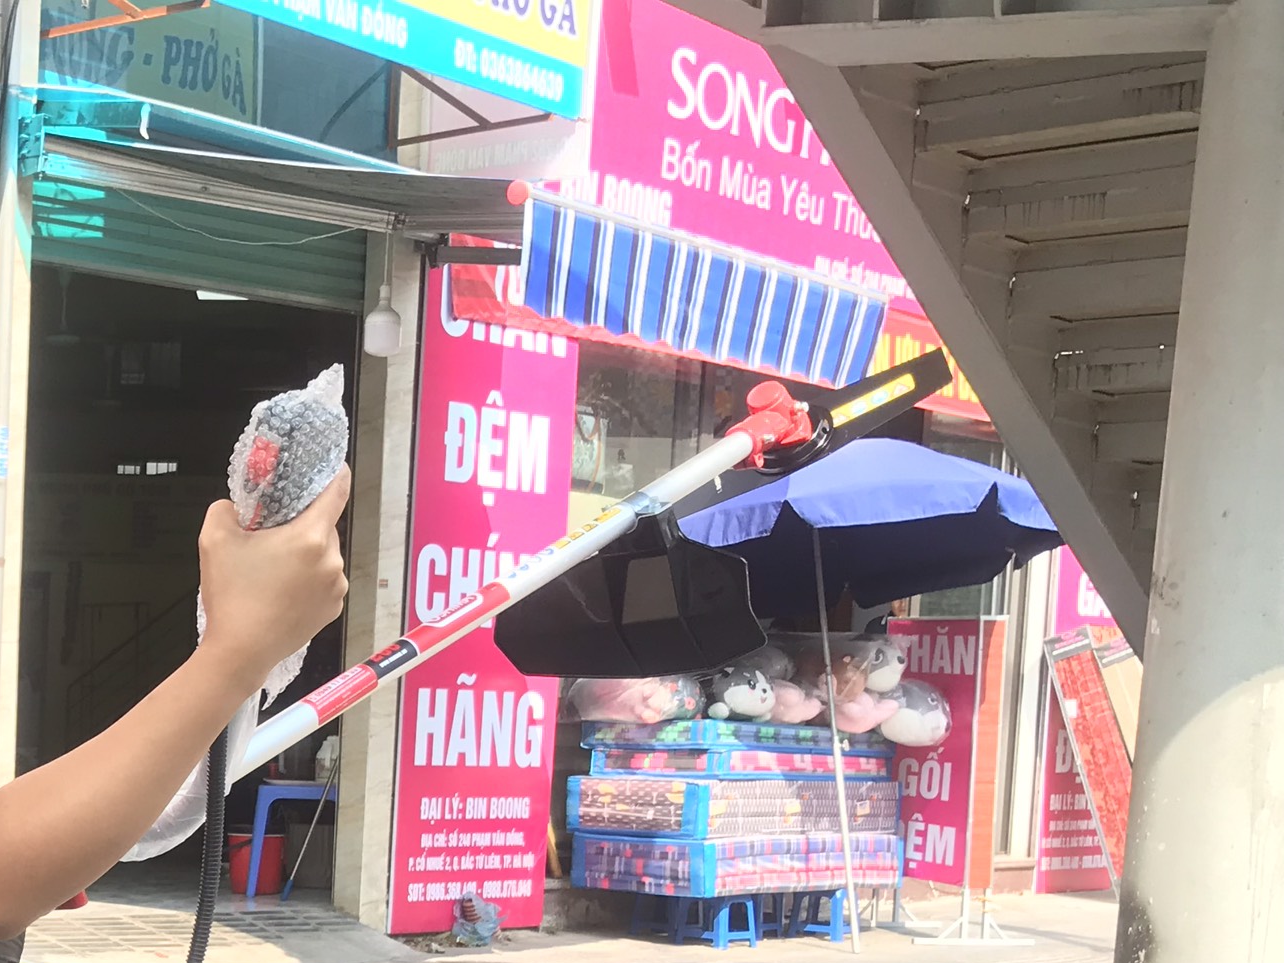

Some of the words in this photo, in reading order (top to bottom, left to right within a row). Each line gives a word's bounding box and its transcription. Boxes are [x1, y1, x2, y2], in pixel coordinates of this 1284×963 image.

[161, 27, 219, 93] PHỞ
[221, 47, 247, 116] GÀ
[660, 136, 713, 193] Bốn
[719, 156, 772, 211] Mùa
[780, 174, 825, 226] Yêu
[444, 390, 550, 506] ĐỆM
[904, 626, 976, 676] HĂN
[414, 673, 545, 768] HÃNG
[420, 796, 443, 825] ĐẠI
[444, 792, 463, 821] LÝ:
[465, 796, 487, 821] BIN
[489, 796, 531, 821] BOONG
[897, 746, 953, 802] GỐI
[900, 813, 956, 869] ỆM
